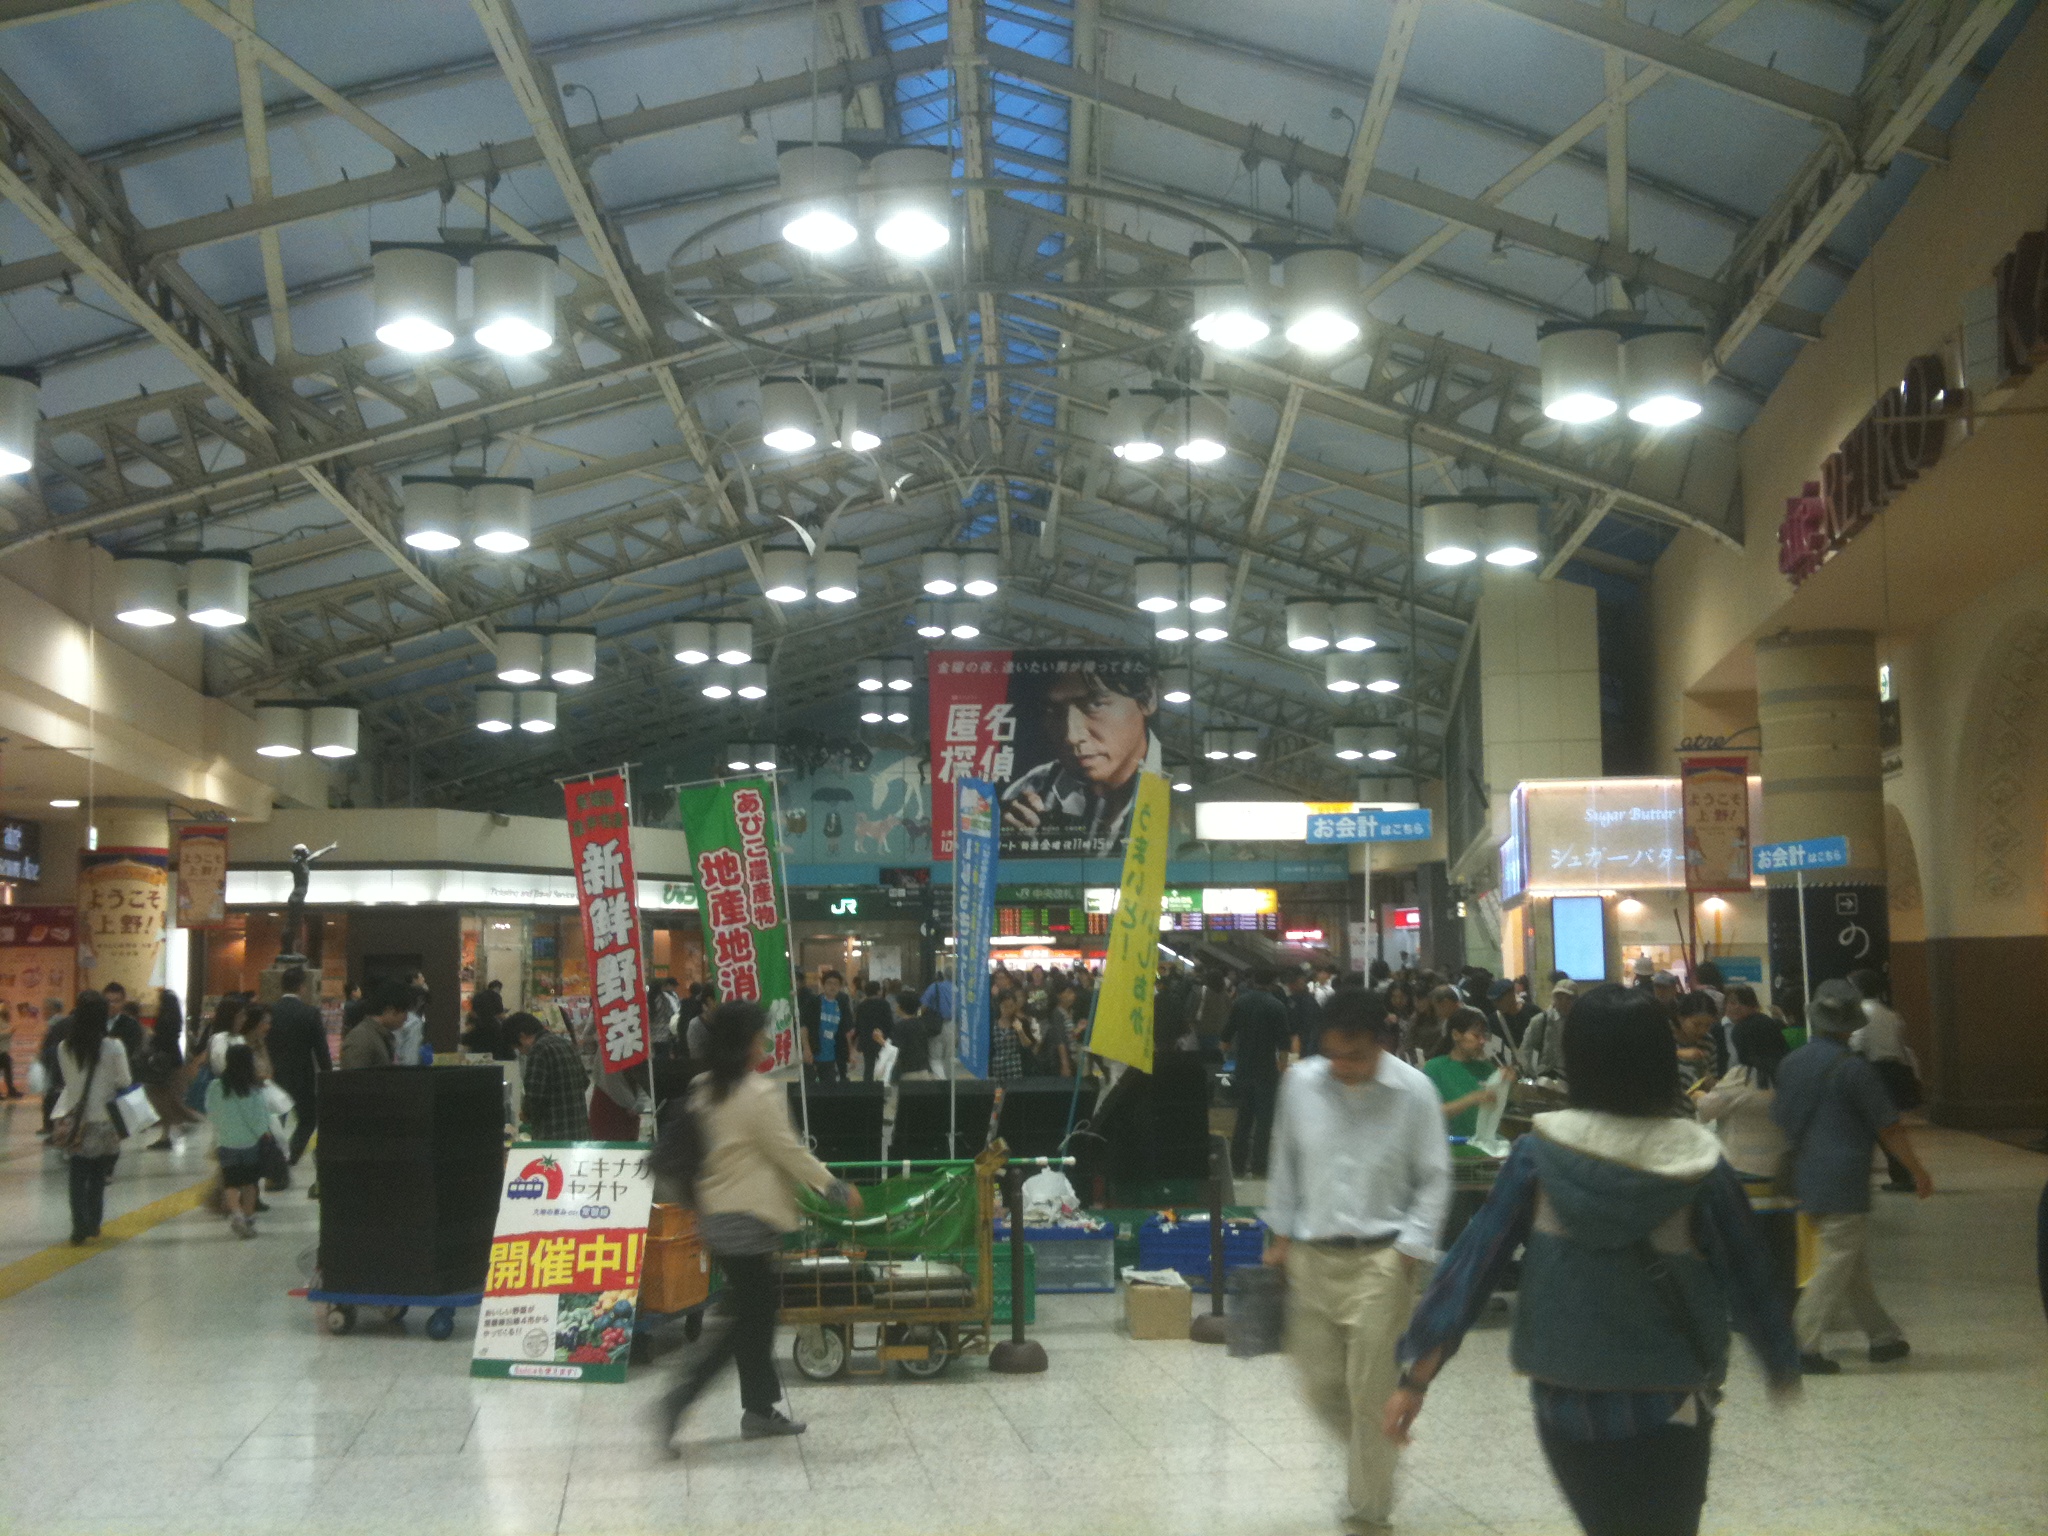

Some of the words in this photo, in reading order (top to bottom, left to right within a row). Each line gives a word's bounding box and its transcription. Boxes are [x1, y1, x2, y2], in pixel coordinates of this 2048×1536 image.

[945, 704, 1016, 741] 匿名
[938, 746, 1015, 783] 探偵
[1585, 808, 1626, 828] Sugar
[89, 889, 160, 909] ようこそ
[831, 898, 858, 914] JR
[96, 914, 154, 934] 上野!
[701, 853, 759, 1000] 地産地消
[581, 838, 645, 1062] 新鮮野菜
[570, 1157, 650, 1180] エキナカ
[568, 1180, 627, 1202] ヤオヤ
